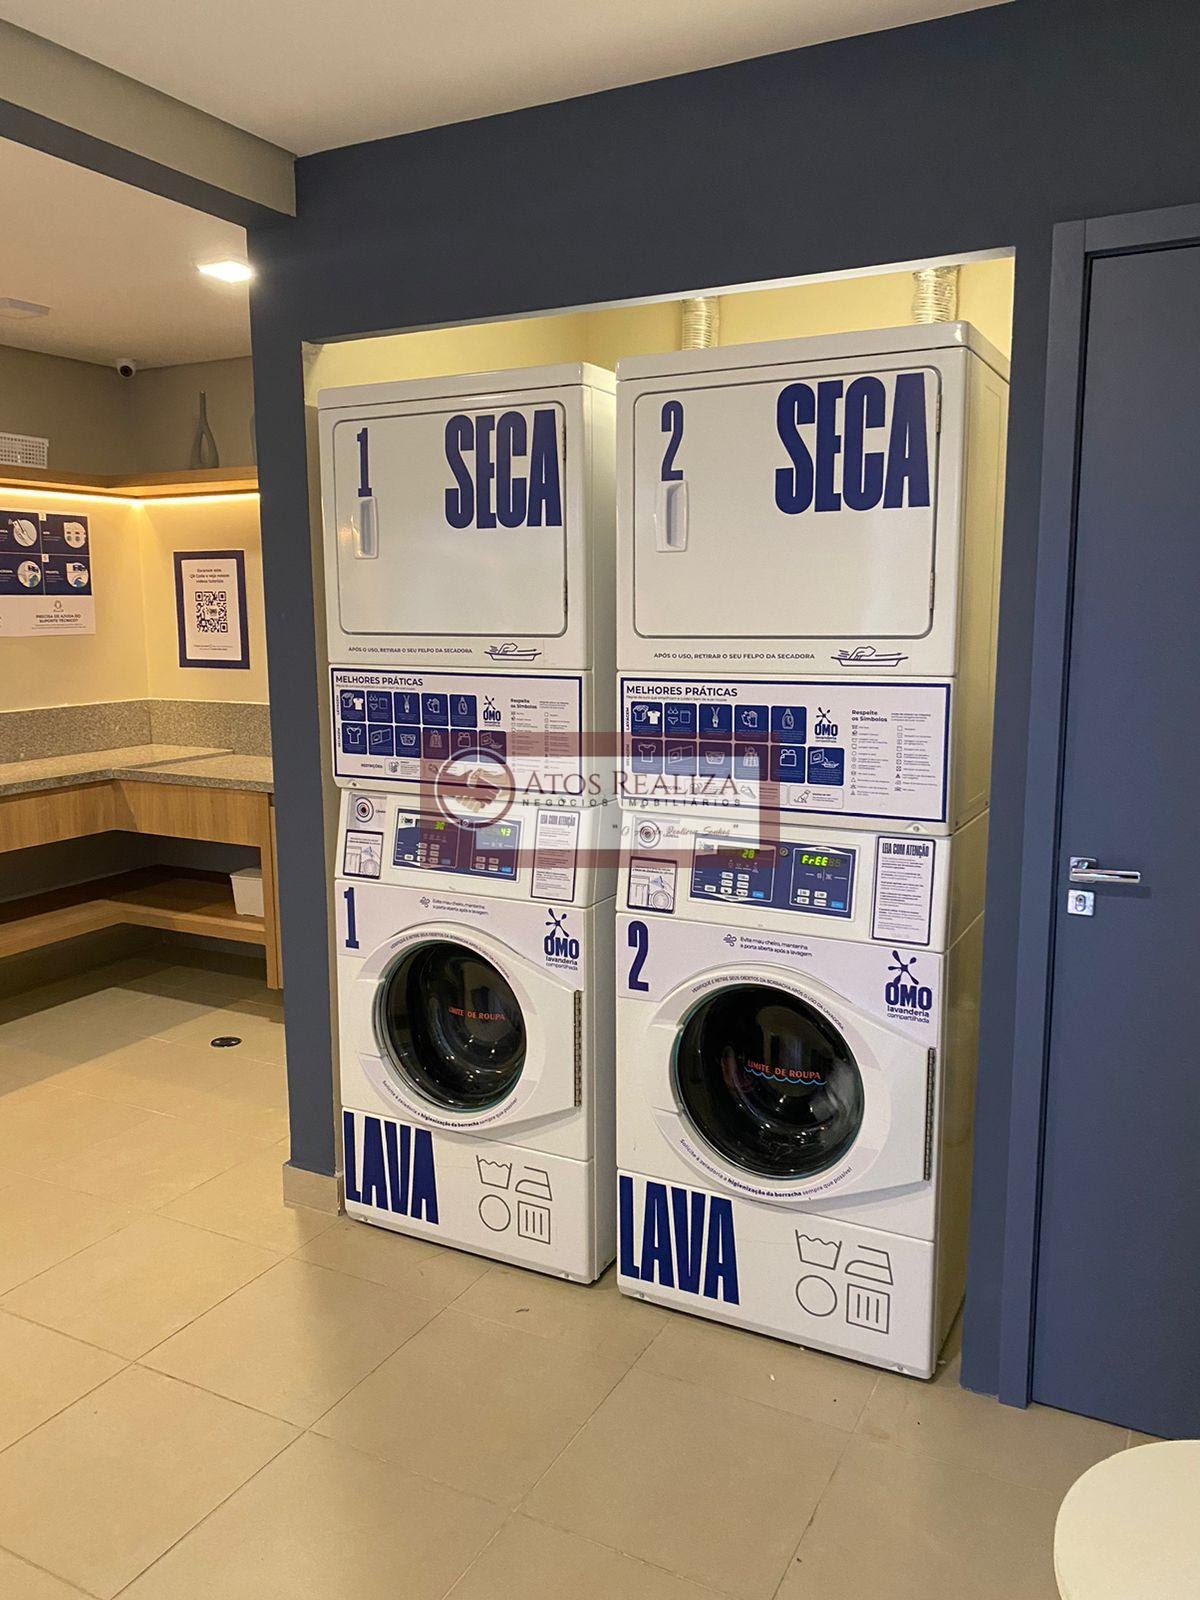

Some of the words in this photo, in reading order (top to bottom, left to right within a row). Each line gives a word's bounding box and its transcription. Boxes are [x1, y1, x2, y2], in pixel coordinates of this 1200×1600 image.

[660, 400, 684, 481] 2
[774, 372, 931, 515] SECA
[356, 427, 373, 497] 1
[444, 408, 563, 529] SECA
[335, 675, 380, 684] MELHORES
[382, 676, 424, 686] PRÁTICAS
[626, 685, 682, 695] MELHORES
[685, 685, 738, 696] PRÁTICAS
[483, 710, 501, 721] OMO
[815, 723, 838, 736] OMO
[882, 842, 891, 854] LEIA
[893, 843, 905, 855] COM
[906, 843, 929, 858] ATENÇÃO
[343, 887, 360, 949] 1
[543, 935, 580, 959] OMO
[781, 942, 808, 950] mantenha
[546, 956, 578, 965] lavanderia
[627, 920, 649, 992] 2
[884, 981, 933, 1011] OMO
[886, 1005, 930, 1018] lavanderia
[886, 1012, 930, 1024] compartilhada
[774, 1067, 787, 1076] DE
[789, 1069, 821, 1080] ROUPA
[343, 1110, 440, 1225] LAVA
[728, 1177, 766, 1196] higienização
[802, 1186, 823, 1196] sempre
[823, 1180, 834, 1189] que
[619, 1174, 740, 1306] LAVA
